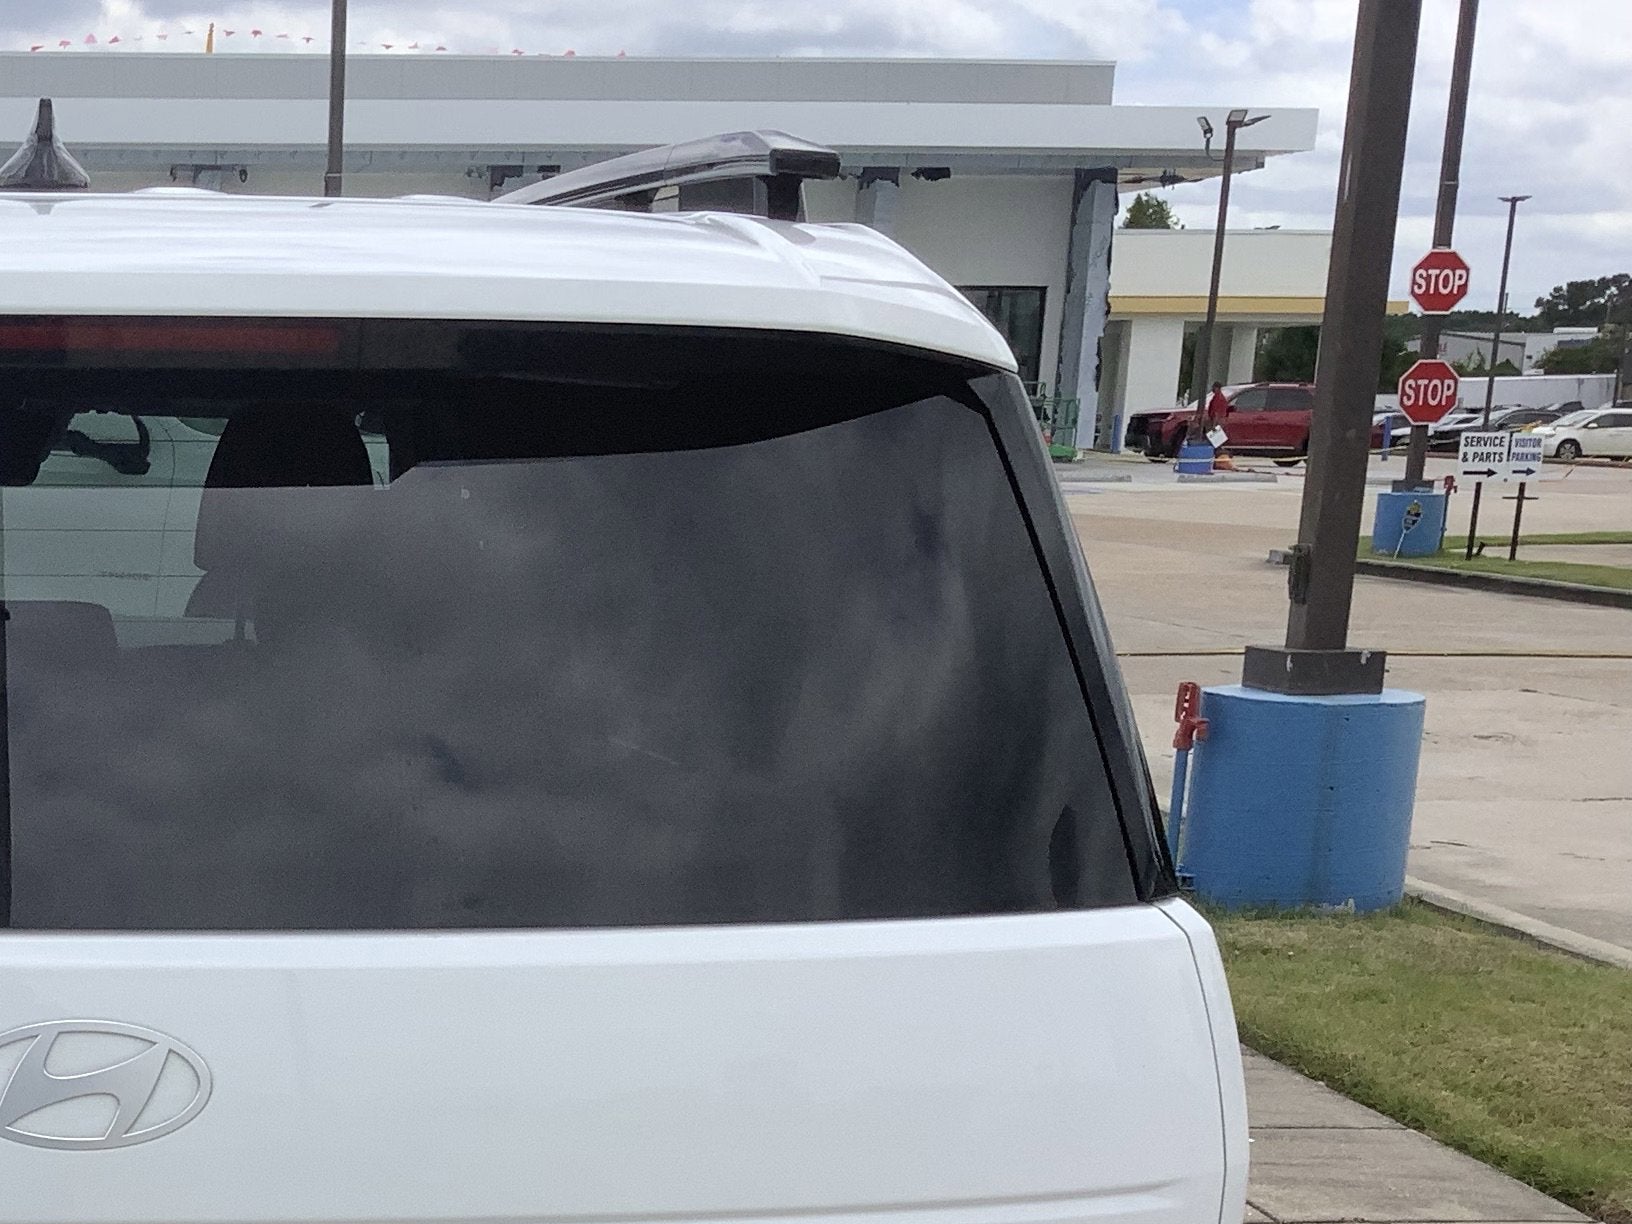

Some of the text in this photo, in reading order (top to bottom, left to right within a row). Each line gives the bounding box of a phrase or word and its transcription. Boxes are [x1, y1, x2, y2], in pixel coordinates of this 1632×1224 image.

[1413, 268, 1467, 295] STOP
[1402, 379, 1456, 406] STOP
[1463, 436, 1506, 447] SERVICE
[1514, 438, 1542, 448] VISITOR
[1461, 452, 1504, 463] & PARTS
[1511, 452, 1542, 462] PARKING
